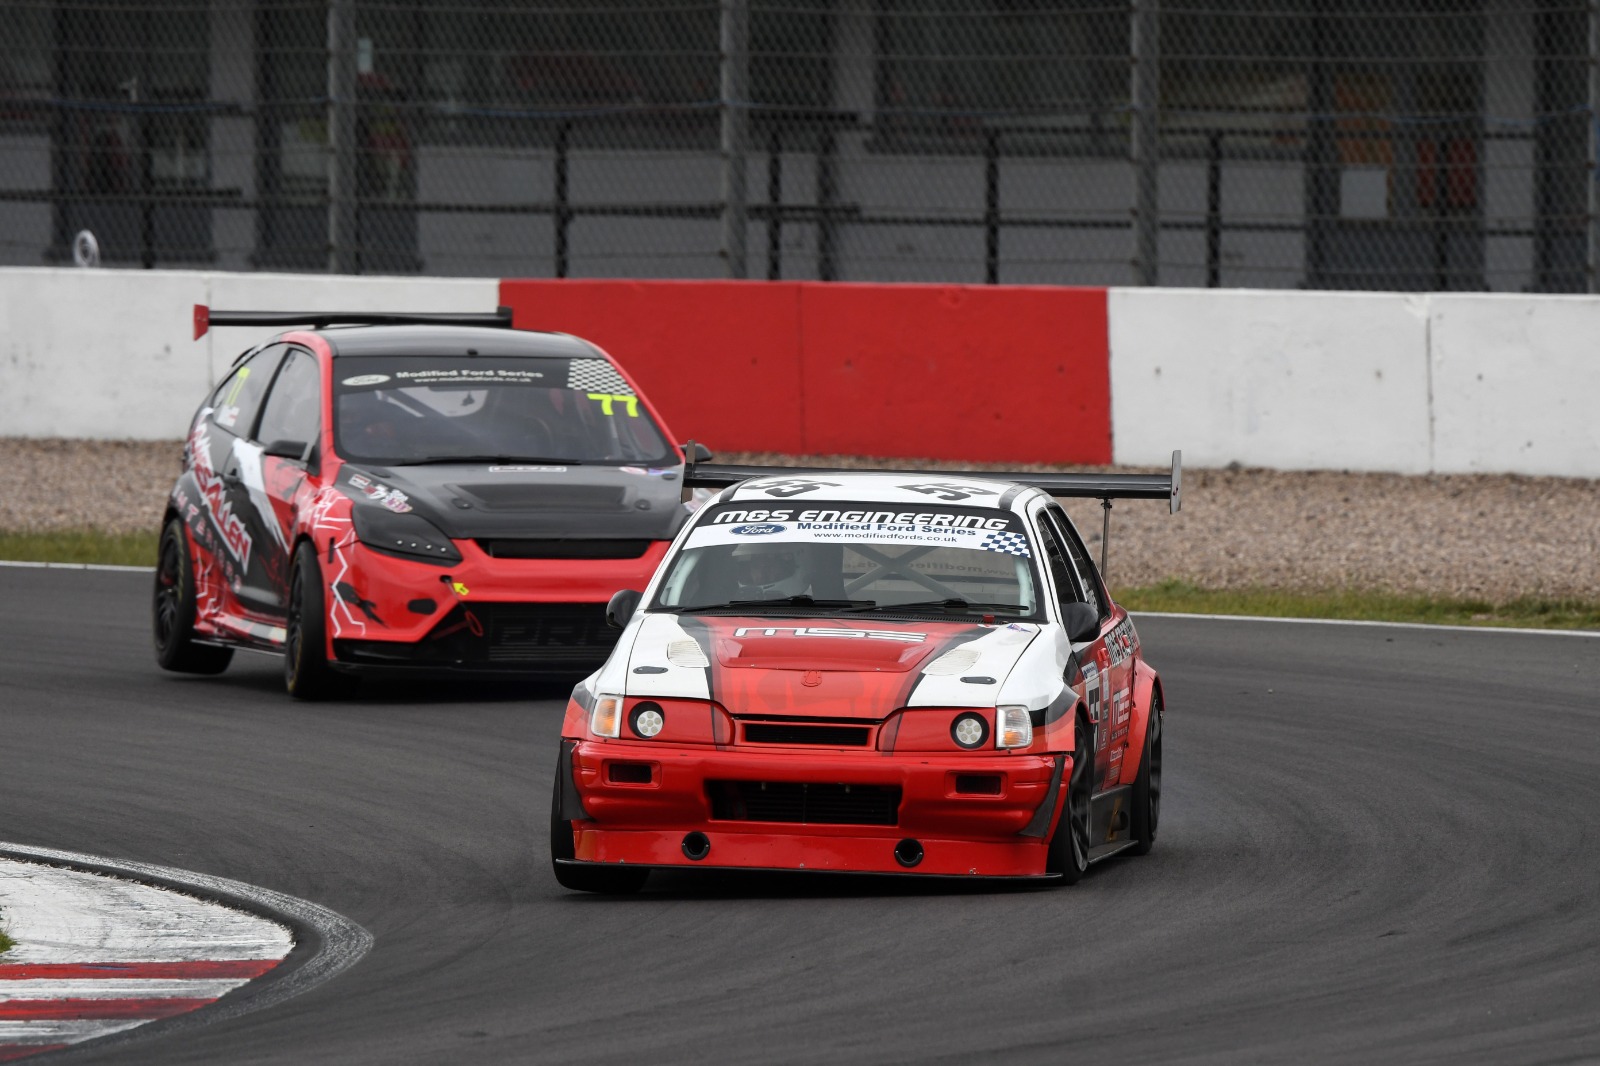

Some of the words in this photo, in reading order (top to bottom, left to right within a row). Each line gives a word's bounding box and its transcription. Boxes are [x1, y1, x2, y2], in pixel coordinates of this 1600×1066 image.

[396, 369, 459, 379] Modified
[461, 369, 495, 377] Ford
[497, 369, 544, 378] Series
[586, 393, 639, 418] 77
[713, 509, 794, 524] M&S
[798, 510, 1010, 530] ENGINEERING
[740, 524, 775, 535] Ford
[797, 522, 871, 531] Modified
[877, 523, 916, 532] Ford
[921, 525, 977, 536] Series
[813, 532, 958, 543] www.modifiedfords.co.uk
